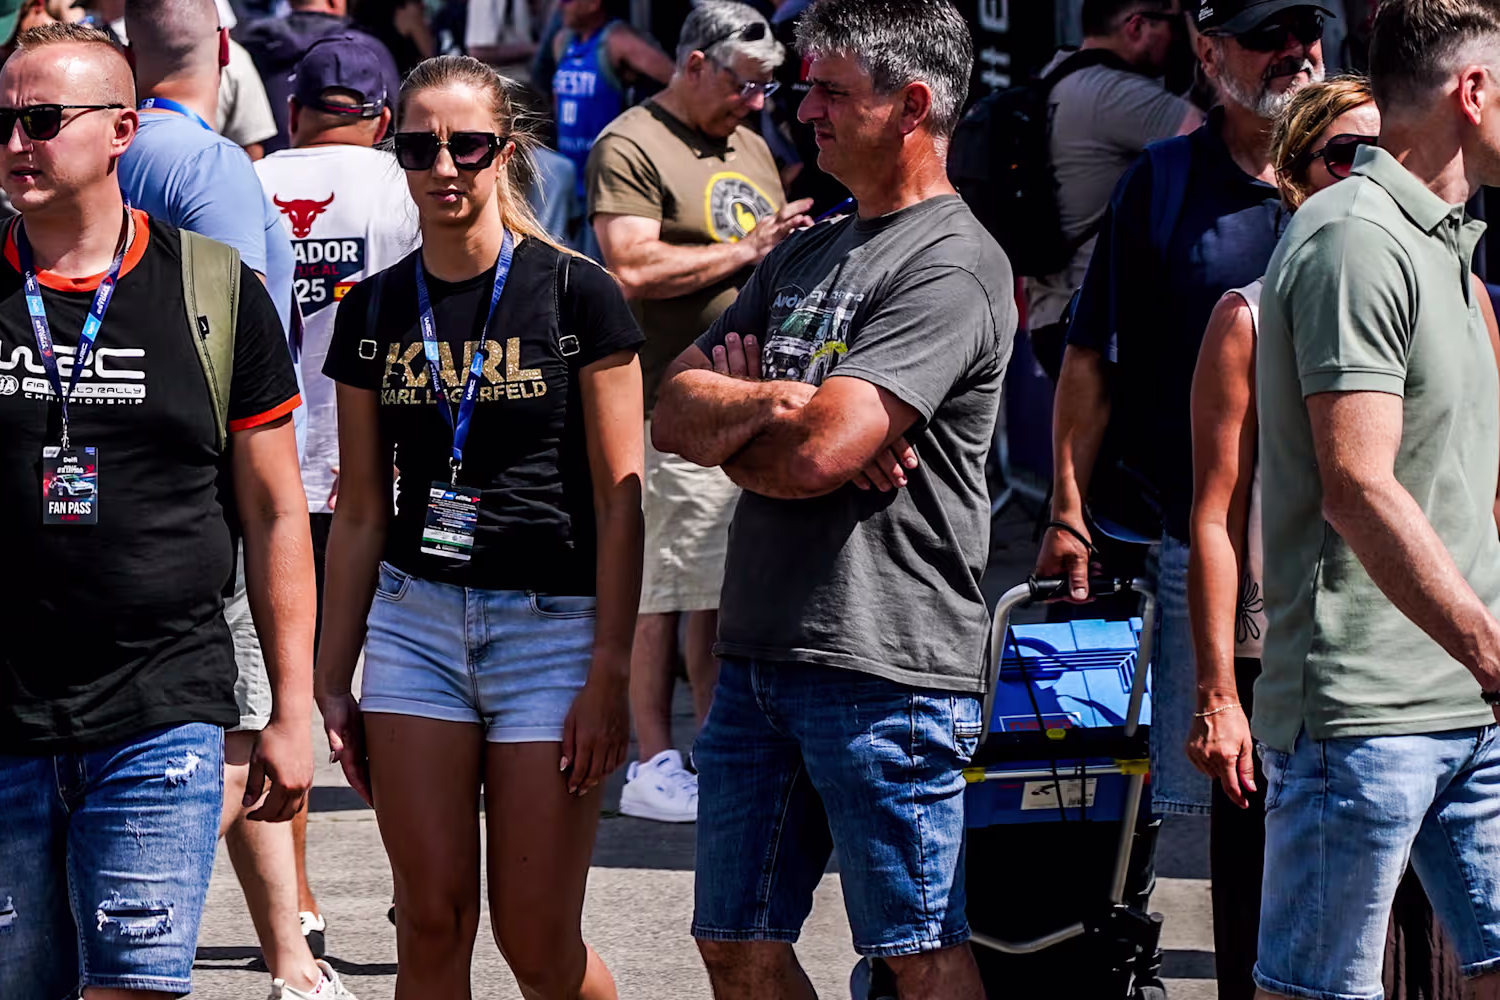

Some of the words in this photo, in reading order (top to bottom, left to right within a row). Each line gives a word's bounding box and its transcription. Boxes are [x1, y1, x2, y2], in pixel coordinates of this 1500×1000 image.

[424, 316, 433, 338] WRC
[78, 342, 88, 365] WRC
[382, 337, 543, 388] KARL
[381, 388, 422, 405] KARL
[466, 379, 476, 401] WRC
[48, 501, 67, 515] FAN
[68, 501, 92, 515] PASS
